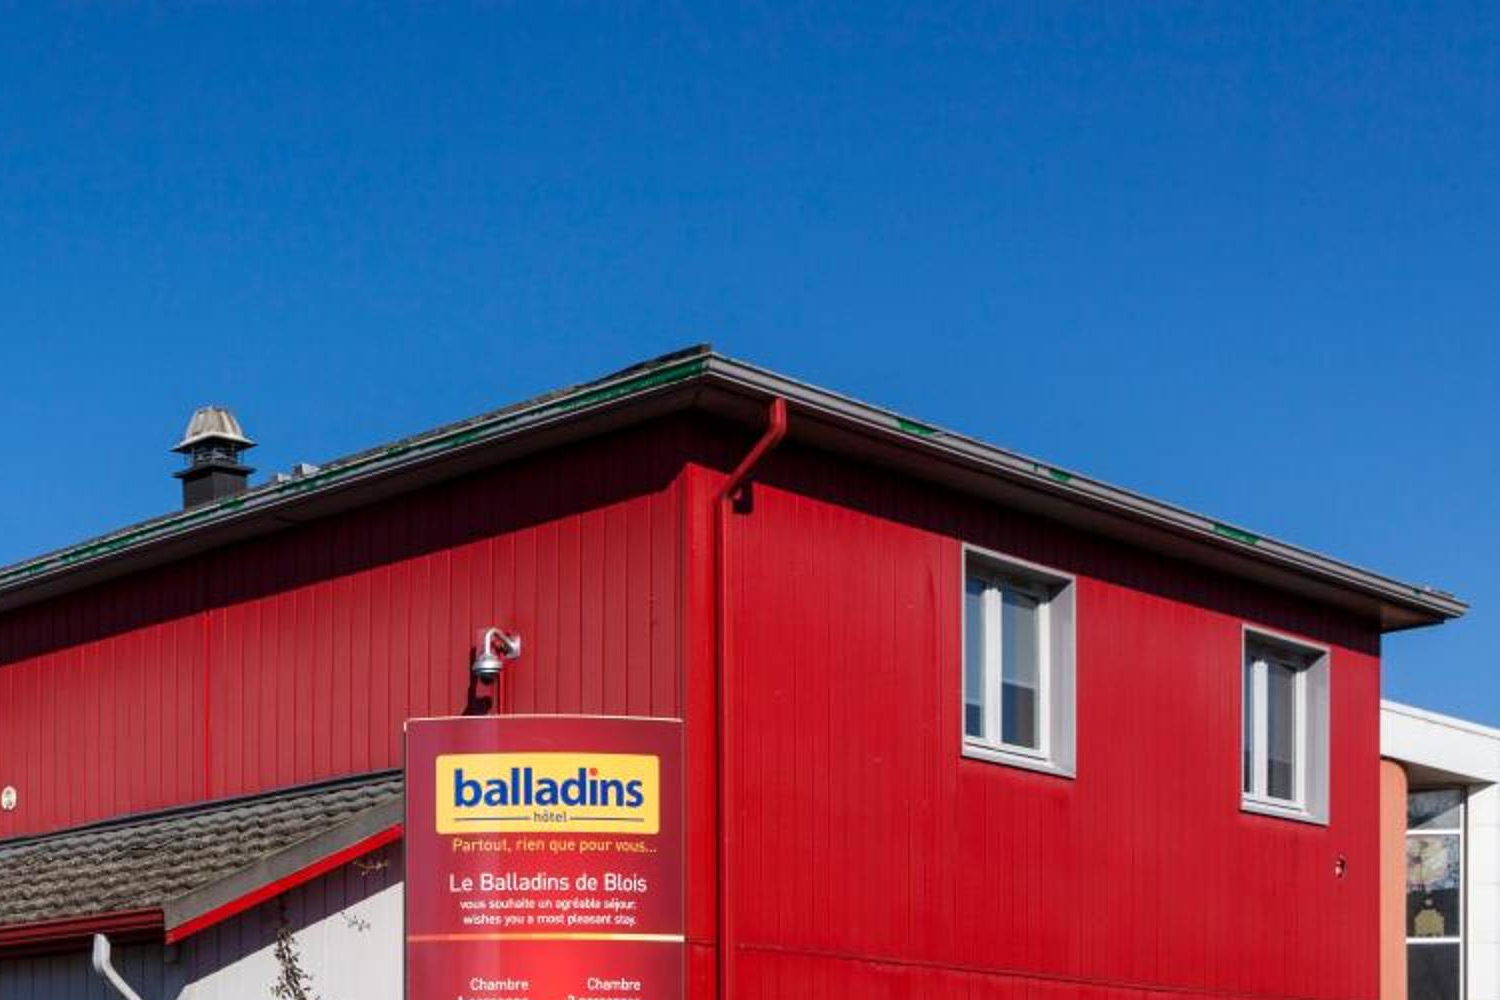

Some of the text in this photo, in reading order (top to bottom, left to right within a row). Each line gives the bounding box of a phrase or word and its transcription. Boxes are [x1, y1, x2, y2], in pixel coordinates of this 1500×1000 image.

[453, 767, 645, 808] balladins
[533, 809, 568, 823] hôtel
[453, 838, 658, 854] Partout, rien que pour vous...
[449, 872, 648, 893] Le Balladins de Blois
[488, 898, 535, 909] souhaite
[538, 899, 553, 909] un
[463, 914, 500, 924] wishes
[504, 915, 525, 927] you
[537, 914, 564, 924] most
[567, 914, 611, 926] pleasant
[470, 977, 529, 991] Chambre
[587, 977, 641, 991] Chambre
